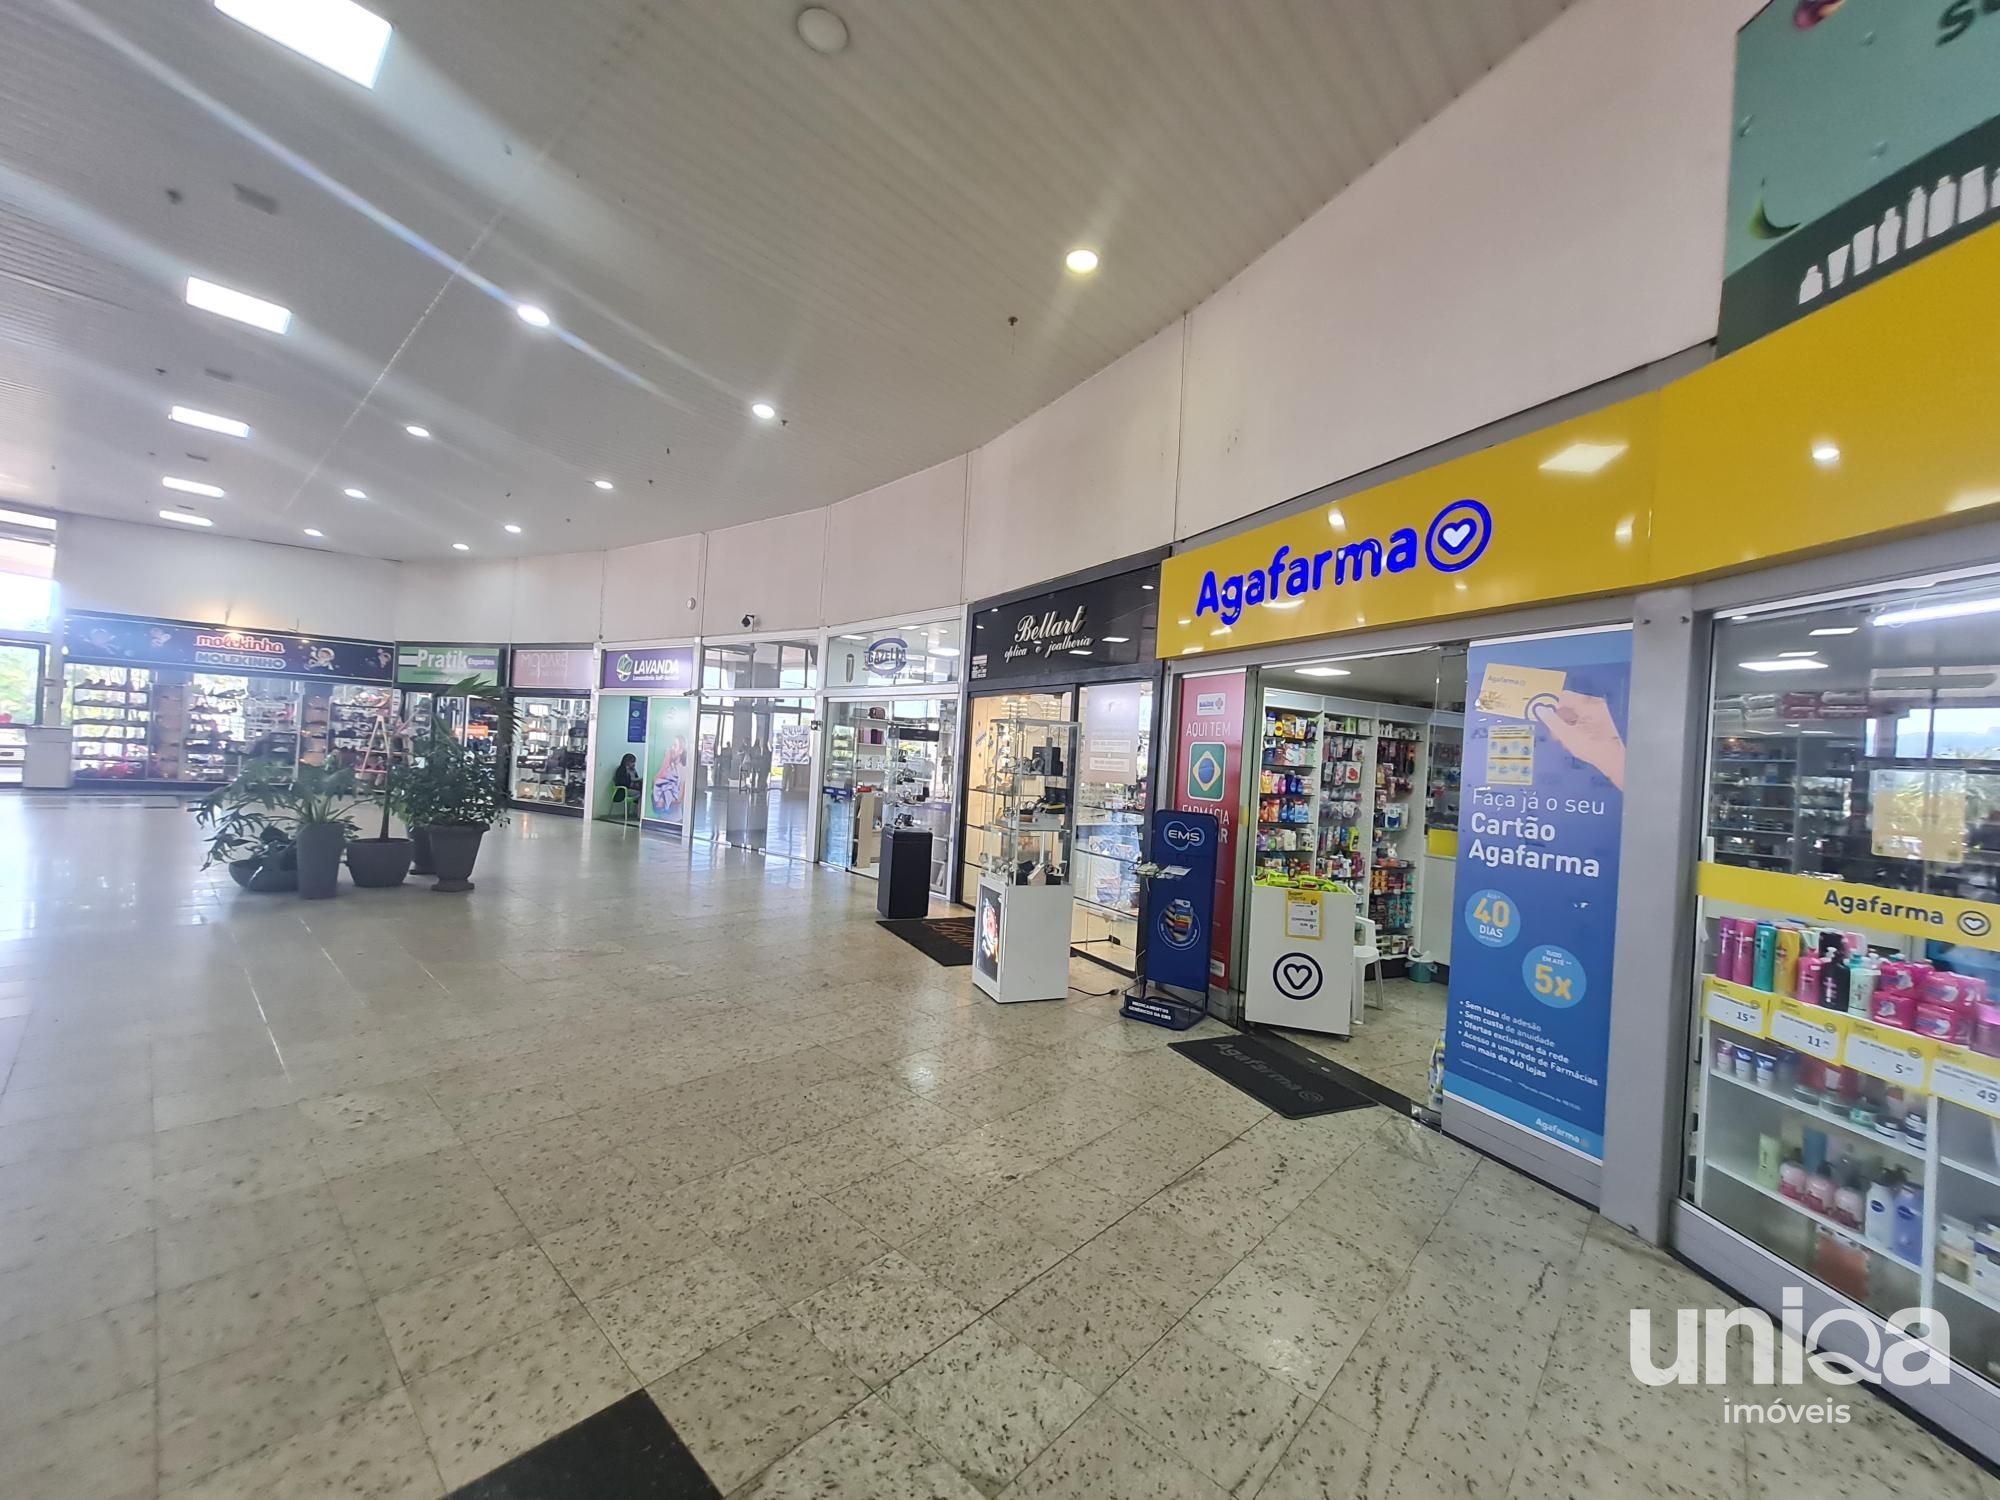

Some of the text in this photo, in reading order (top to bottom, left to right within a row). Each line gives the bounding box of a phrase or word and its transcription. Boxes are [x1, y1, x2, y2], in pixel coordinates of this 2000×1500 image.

[1196, 527, 1418, 626] Agafarma
[1014, 605, 1085, 642] Bellart
[197, 633, 285, 653] molekinha
[1045, 635, 1091, 658] joalheria
[196, 651, 286, 669] MOLEKINHO
[417, 649, 468, 668] Pratik
[633, 659, 679, 674] LAVANDA
[1186, 721, 1231, 737] AQUI TEM
[1472, 787, 1604, 815] Faça já o seu
[1168, 829, 1200, 841] EMS
[1471, 812, 1556, 841] Cartão
[1468, 838, 1600, 878] Agafarma
[1473, 898, 1510, 928] 40
[1824, 889, 1944, 925] Agafarma
[1479, 924, 1503, 938] DIAS
[1535, 963, 1572, 1001] 5x
[1132, 1001, 1169, 1013] MEDICAMENTOS
[1465, 1000, 1542, 1032] Sem taxa de adesão
[1737, 1011, 1749, 1022] 15
[1463, 1016, 1569, 1064] Ofertas exclusivas da rede
[1464, 1010, 1555, 1048] Sem custo de anuidade
[1807, 1035, 1821, 1048] 11
[1461, 1041, 1477, 1051] com
[1478, 1047, 1496, 1059] mais
[1498, 1054, 1508, 1064] de
[1526, 1064, 1547, 1078] lojas
[1463, 1031, 1598, 1086] Acesso a uma rede de Farmácias
[1976, 1089, 1998, 1104] 49
[1535, 1117, 1580, 1143] Agafarma
